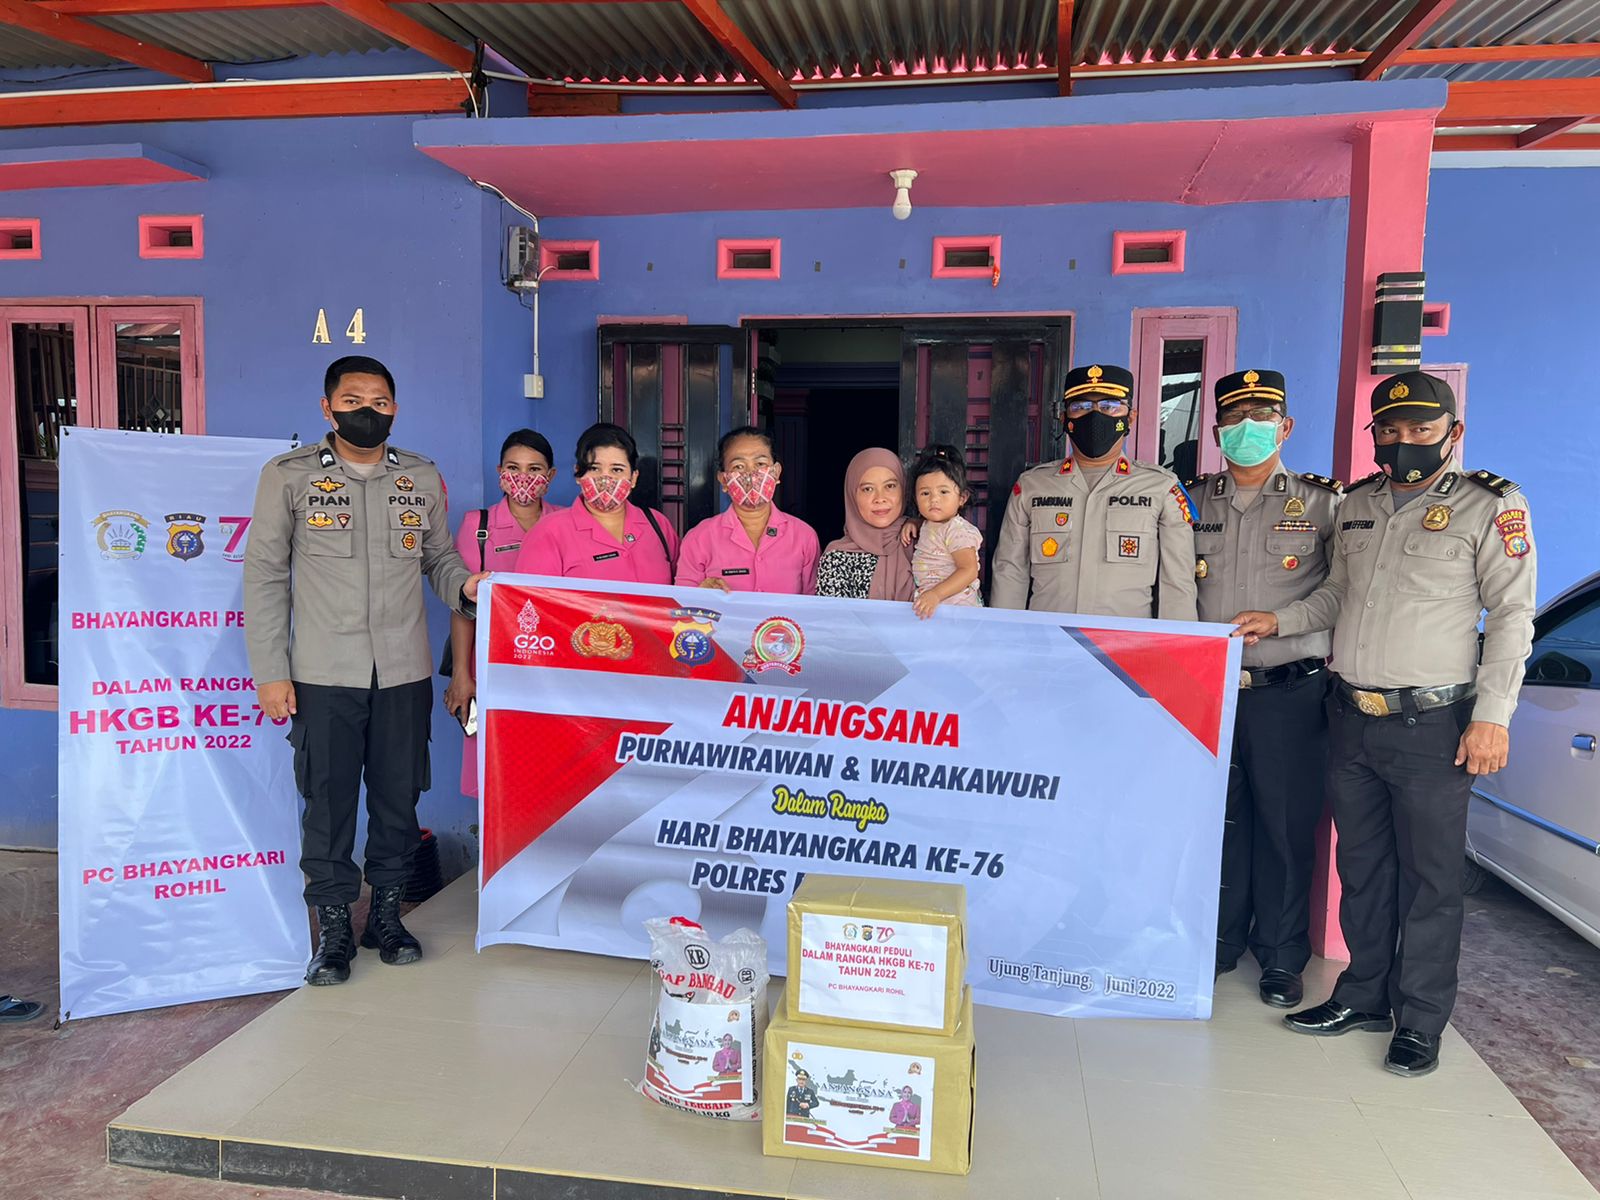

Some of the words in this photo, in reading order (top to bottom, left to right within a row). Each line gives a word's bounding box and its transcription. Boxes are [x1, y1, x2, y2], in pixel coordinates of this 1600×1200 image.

[312, 308, 332, 344] A
[346, 308, 366, 344] 4
[308, 495, 350, 507] PIAN
[388, 495, 426, 507] POLRI
[1109, 496, 1151, 507] POLRI
[168, 514, 202, 522] RIAU
[219, 516, 252, 553] 7
[71, 611, 217, 630] BHAYANGKARI
[675, 609, 717, 619] RIAU
[514, 634, 555, 650] G20
[92, 678, 171, 695] DALAM
[180, 677, 256, 692] RANGK
[70, 705, 180, 734] HKGB
[722, 694, 960, 748] ANJANGSANA
[116, 735, 196, 754] TAHUN
[204, 734, 252, 749] 2022
[618, 735, 834, 778] PURNAWIRAWAN
[840, 756, 861, 782] &
[871, 758, 1061, 801] WARAKAWURI
[773, 785, 827, 817] Dalam
[829, 792, 888, 831] Rangka
[657, 819, 720, 849] HARI
[726, 826, 917, 869] BHAYANGKARA
[925, 846, 1004, 879] KE-76
[82, 867, 114, 884] PC
[123, 850, 285, 880] BHAYANGKARI
[154, 878, 226, 900] ROHIL
[691, 862, 787, 895] POLRES
[687, 949, 706, 965] KB
[802, 948, 834, 961] DALAM
[836, 954, 876, 965] RANGKA
[878, 956, 906, 968] HKGB
[908, 960, 935, 972] KE-70
[825, 941, 882, 954] BHAYANGKARI
[884, 946, 913, 958] PEDULI
[839, 966, 872, 977] TAHUN
[874, 968, 897, 979] 2022
[989, 958, 1030, 981] Ujung
[1033, 965, 1094, 990] Tanjung,
[1104, 975, 1135, 994] Juni
[1138, 980, 1176, 999] 2022
[688, 972, 737, 999] BANGAU
[838, 984, 885, 994] BHAYANGKARI
[885, 988, 906, 997] ROHIL
